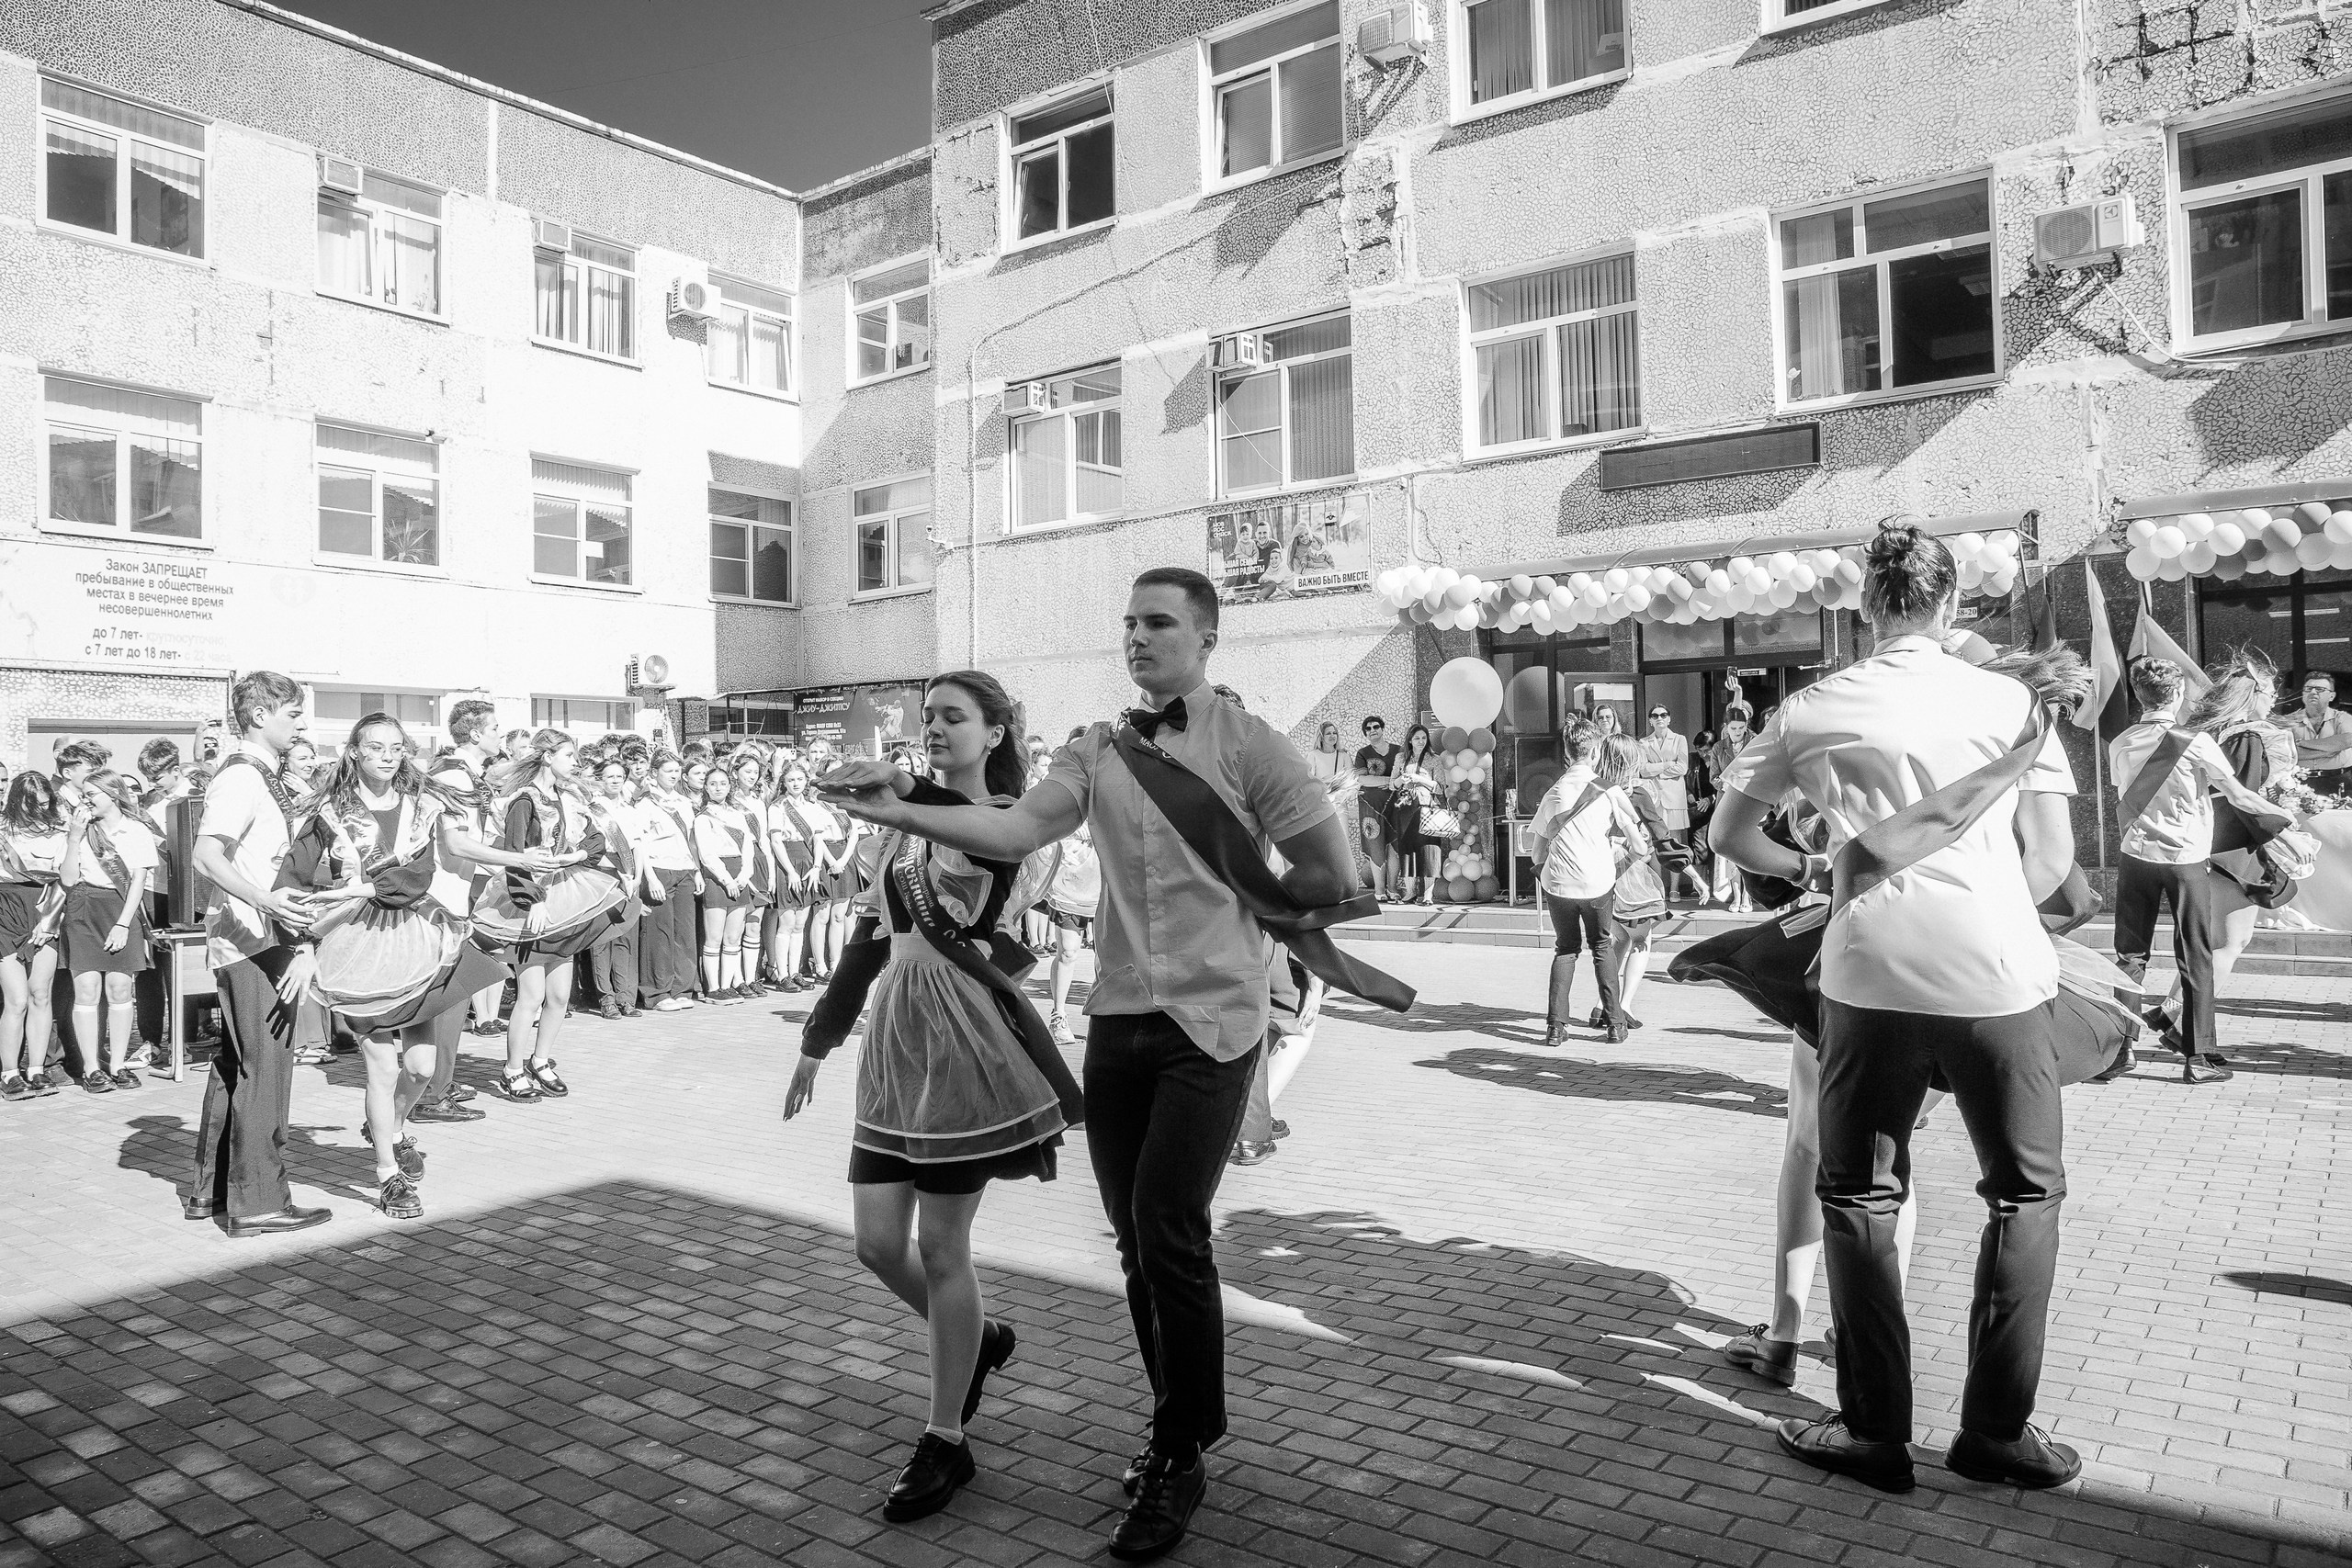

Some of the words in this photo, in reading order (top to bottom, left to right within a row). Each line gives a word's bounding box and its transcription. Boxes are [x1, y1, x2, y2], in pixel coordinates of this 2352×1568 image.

[106, 558, 139, 572] Закон
[142, 562, 208, 579] ЗАПРЕЩАЕТ
[75, 571, 145, 588] пребывание
[149, 581, 154, 589] в
[158, 578, 234, 595] общественных
[1298, 575, 1321, 588] ВАЖНО
[1323, 573, 1341, 585] БЫТЬ
[1342, 570, 1369, 582] ВМЕСТЕ
[87, 587, 125, 600] местах
[129, 591, 135, 601] в
[139, 592, 188, 607] вечернее
[192, 595, 224, 609] время
[99, 604, 213, 620] несовершеннолетних
[93, 627, 107, 640] до
[111, 626, 117, 639] 7
[120, 629, 143, 641] лет-
[85, 645, 92, 656] с
[95, 643, 101, 656] 7
[104, 646, 124, 658] лет
[126, 646, 141, 660] до
[144, 645, 156, 659] 18
[159, 649, 182, 660] лет-
[193, 649, 205, 662] 22
[797, 702, 850, 714] ДЖИУ-ДЖИТСУ
[918, 865, 934, 908] Екатерина
